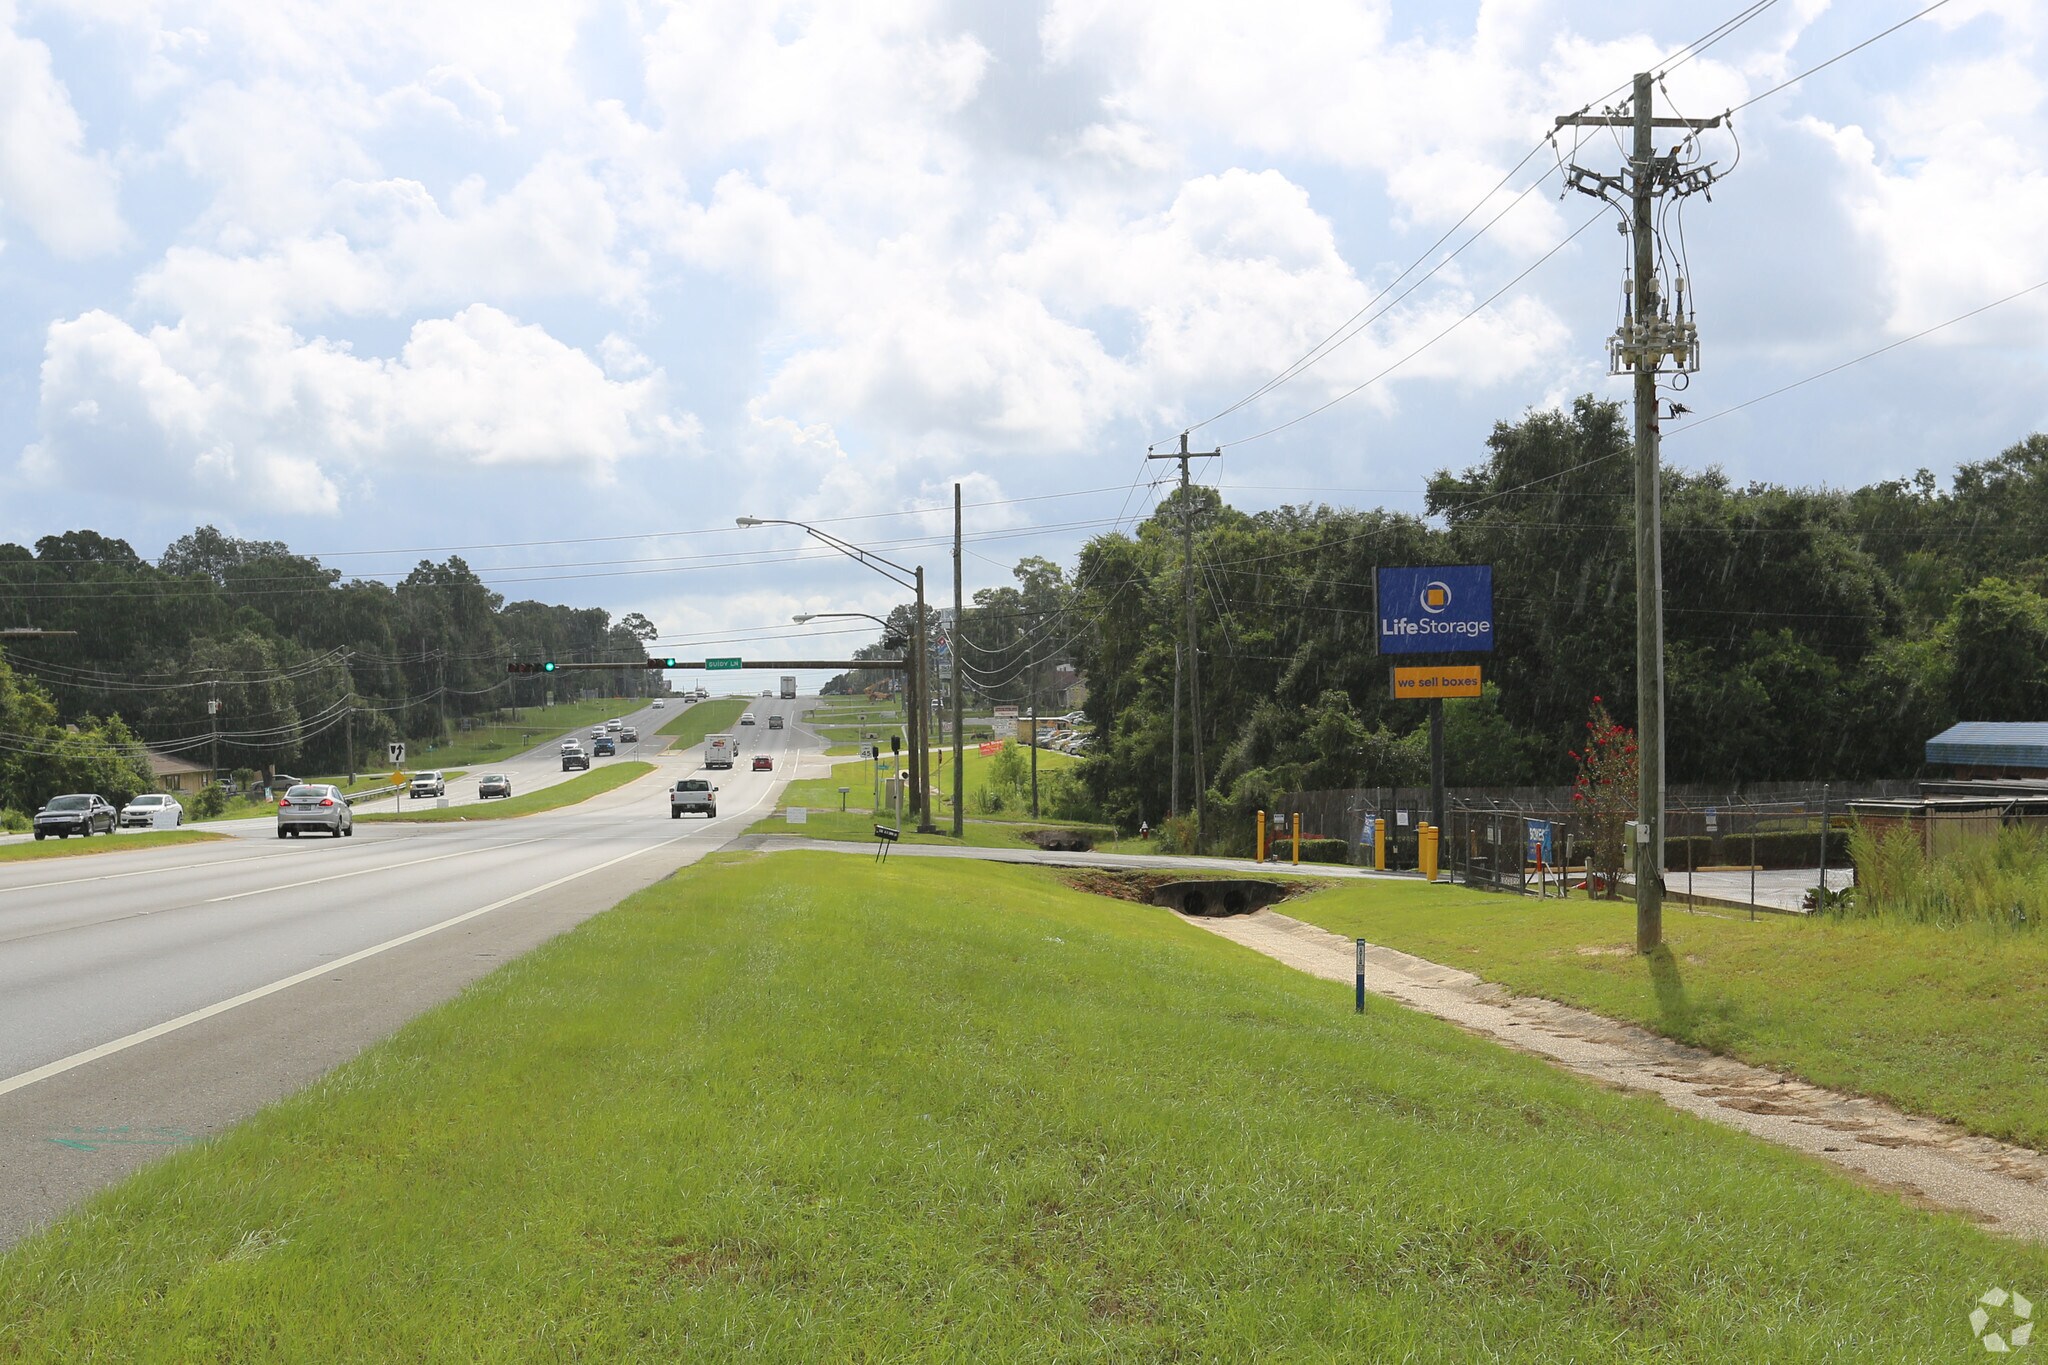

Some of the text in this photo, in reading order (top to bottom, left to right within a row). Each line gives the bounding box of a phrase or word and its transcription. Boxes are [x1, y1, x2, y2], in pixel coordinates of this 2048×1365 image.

[730, 659, 739, 667] LN
[1398, 677, 1478, 688] we sell boxes
